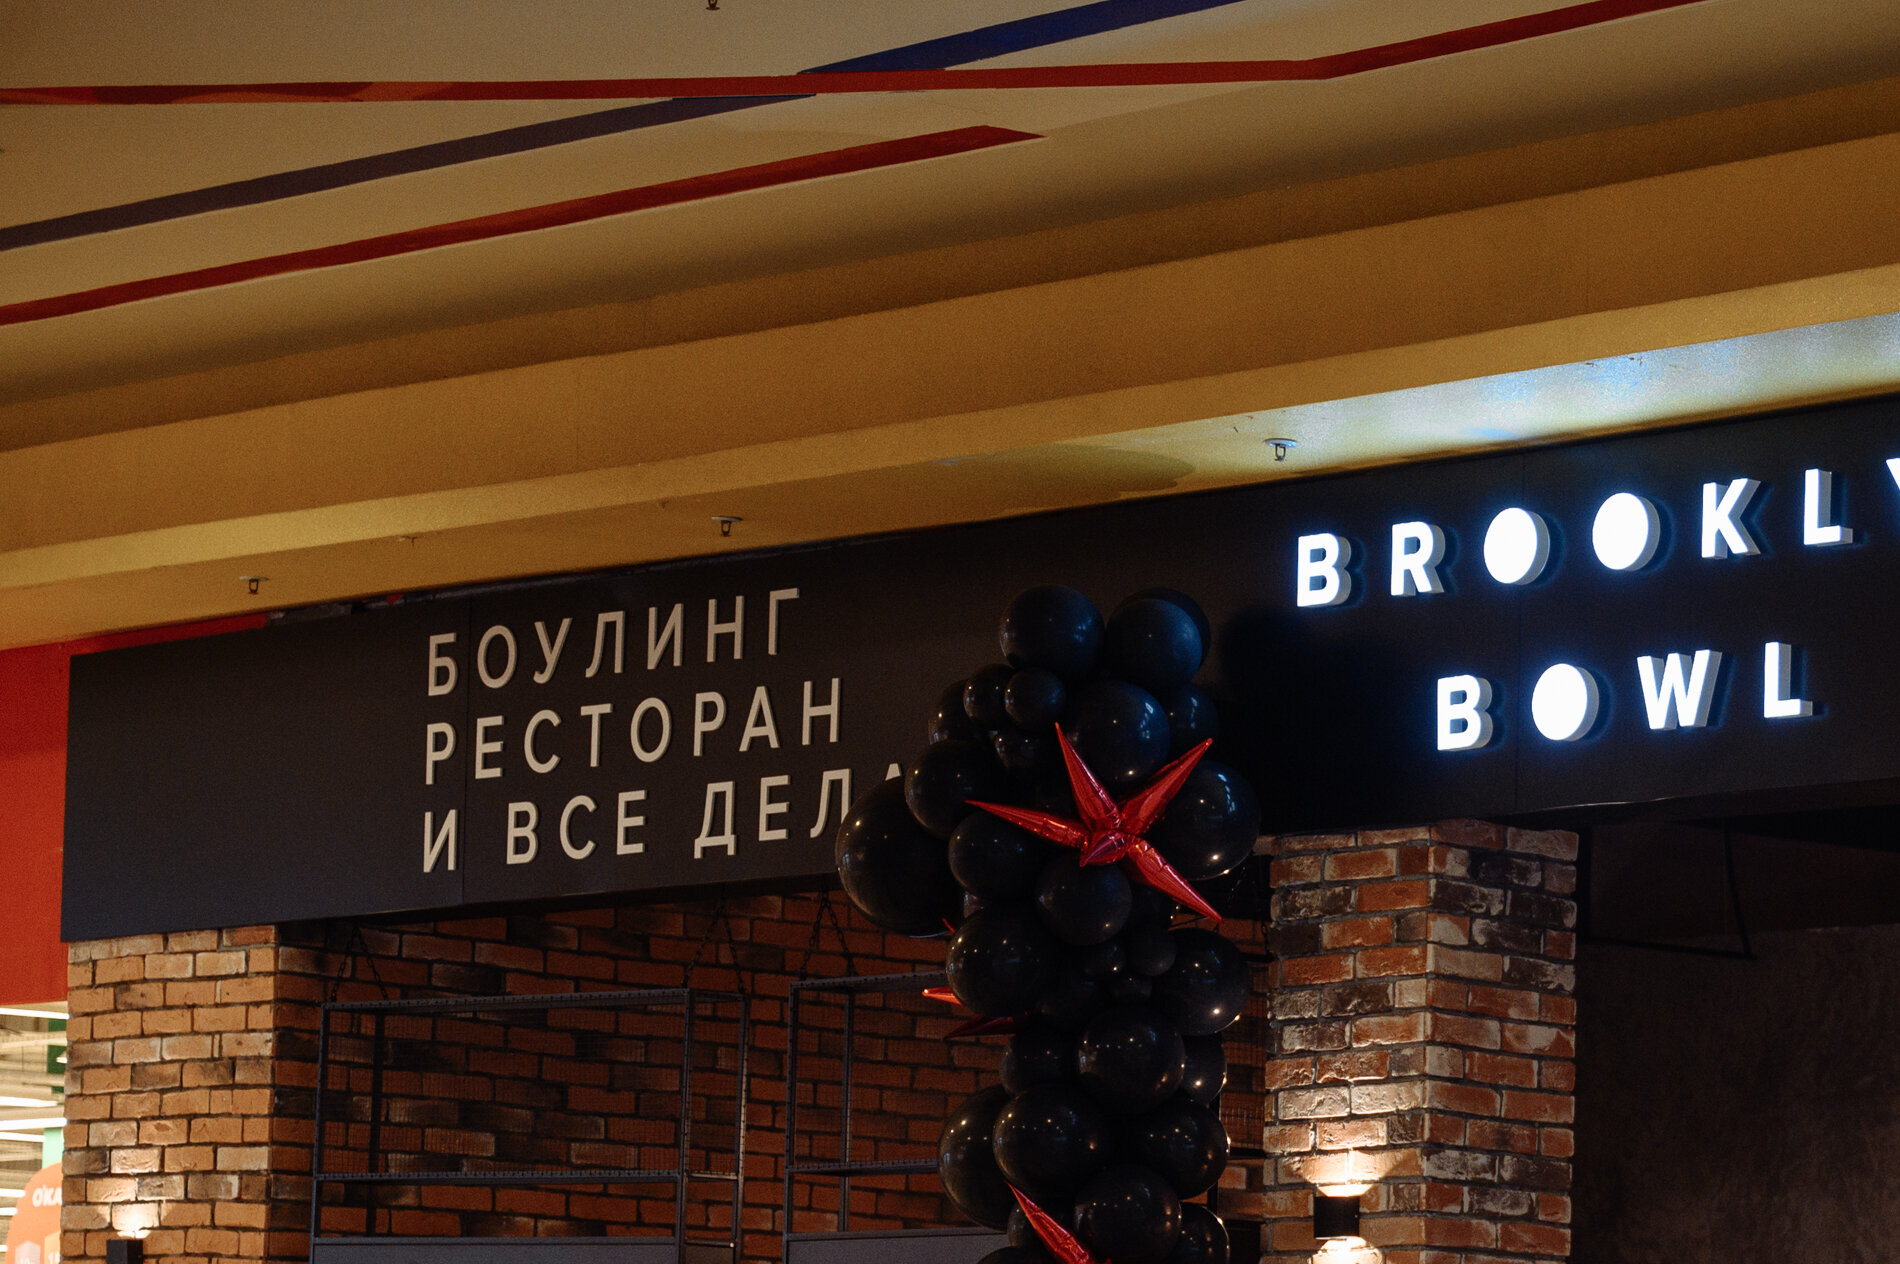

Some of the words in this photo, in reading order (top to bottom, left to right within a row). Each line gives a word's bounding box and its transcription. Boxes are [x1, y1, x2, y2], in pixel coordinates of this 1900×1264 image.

[427, 588, 799, 697] БОУЛИНГ
[1436, 641, 1814, 751] BOWL
[424, 677, 843, 786] РЕСТОРАН
[422, 809, 459, 873] И
[505, 789, 649, 866] ВСЕ
[693, 763, 902, 860] ДЕЛ
